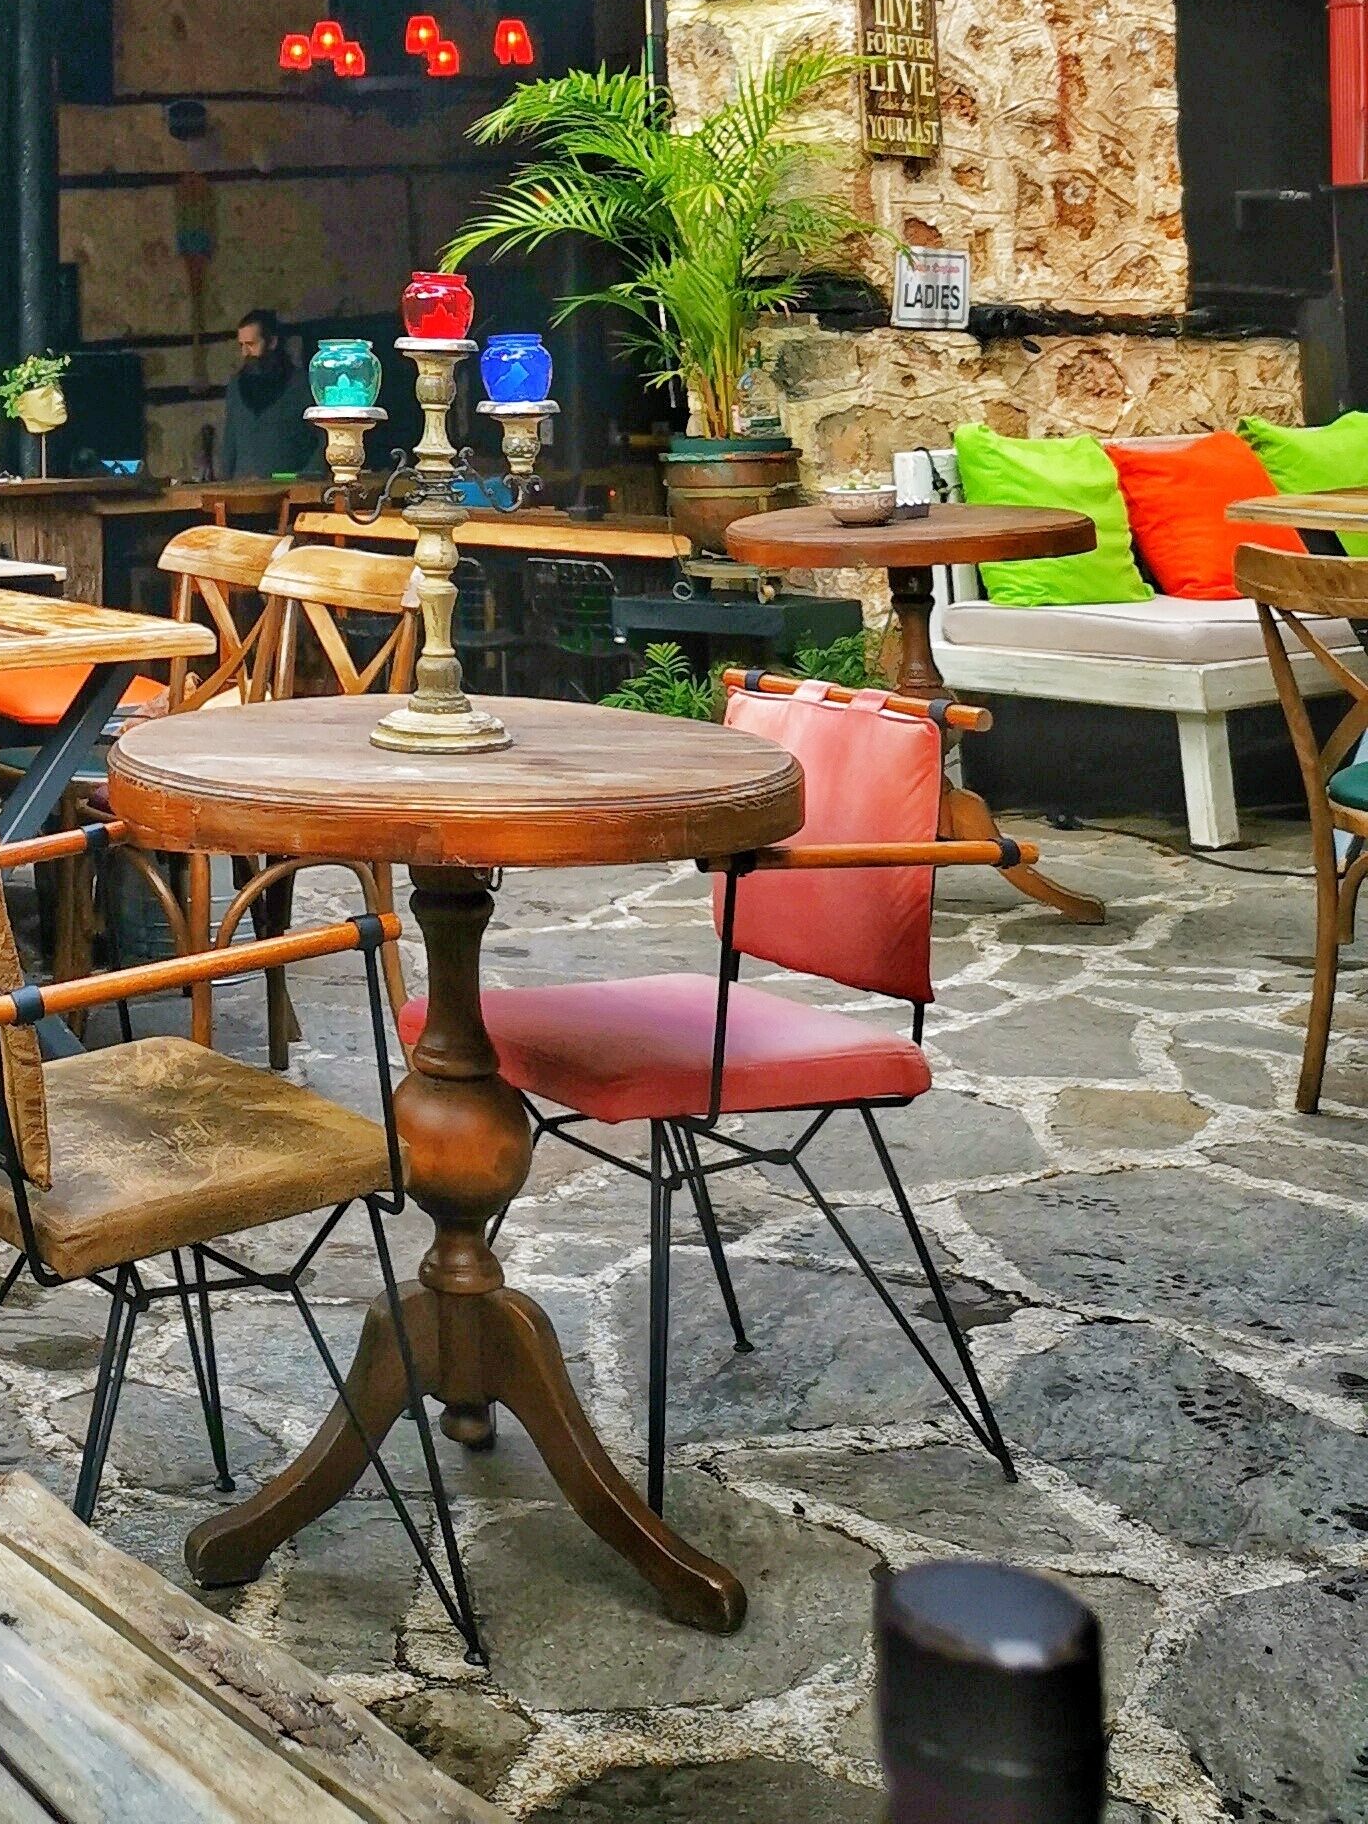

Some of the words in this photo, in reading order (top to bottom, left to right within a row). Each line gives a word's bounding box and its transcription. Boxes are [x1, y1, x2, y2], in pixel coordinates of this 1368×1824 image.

[866, 31, 935, 60] FOREVER
[870, 61, 936, 97] LIVE
[867, 114, 906, 143] YOUR
[907, 117, 939, 145] LAST
[904, 283, 960, 310] LADIES
